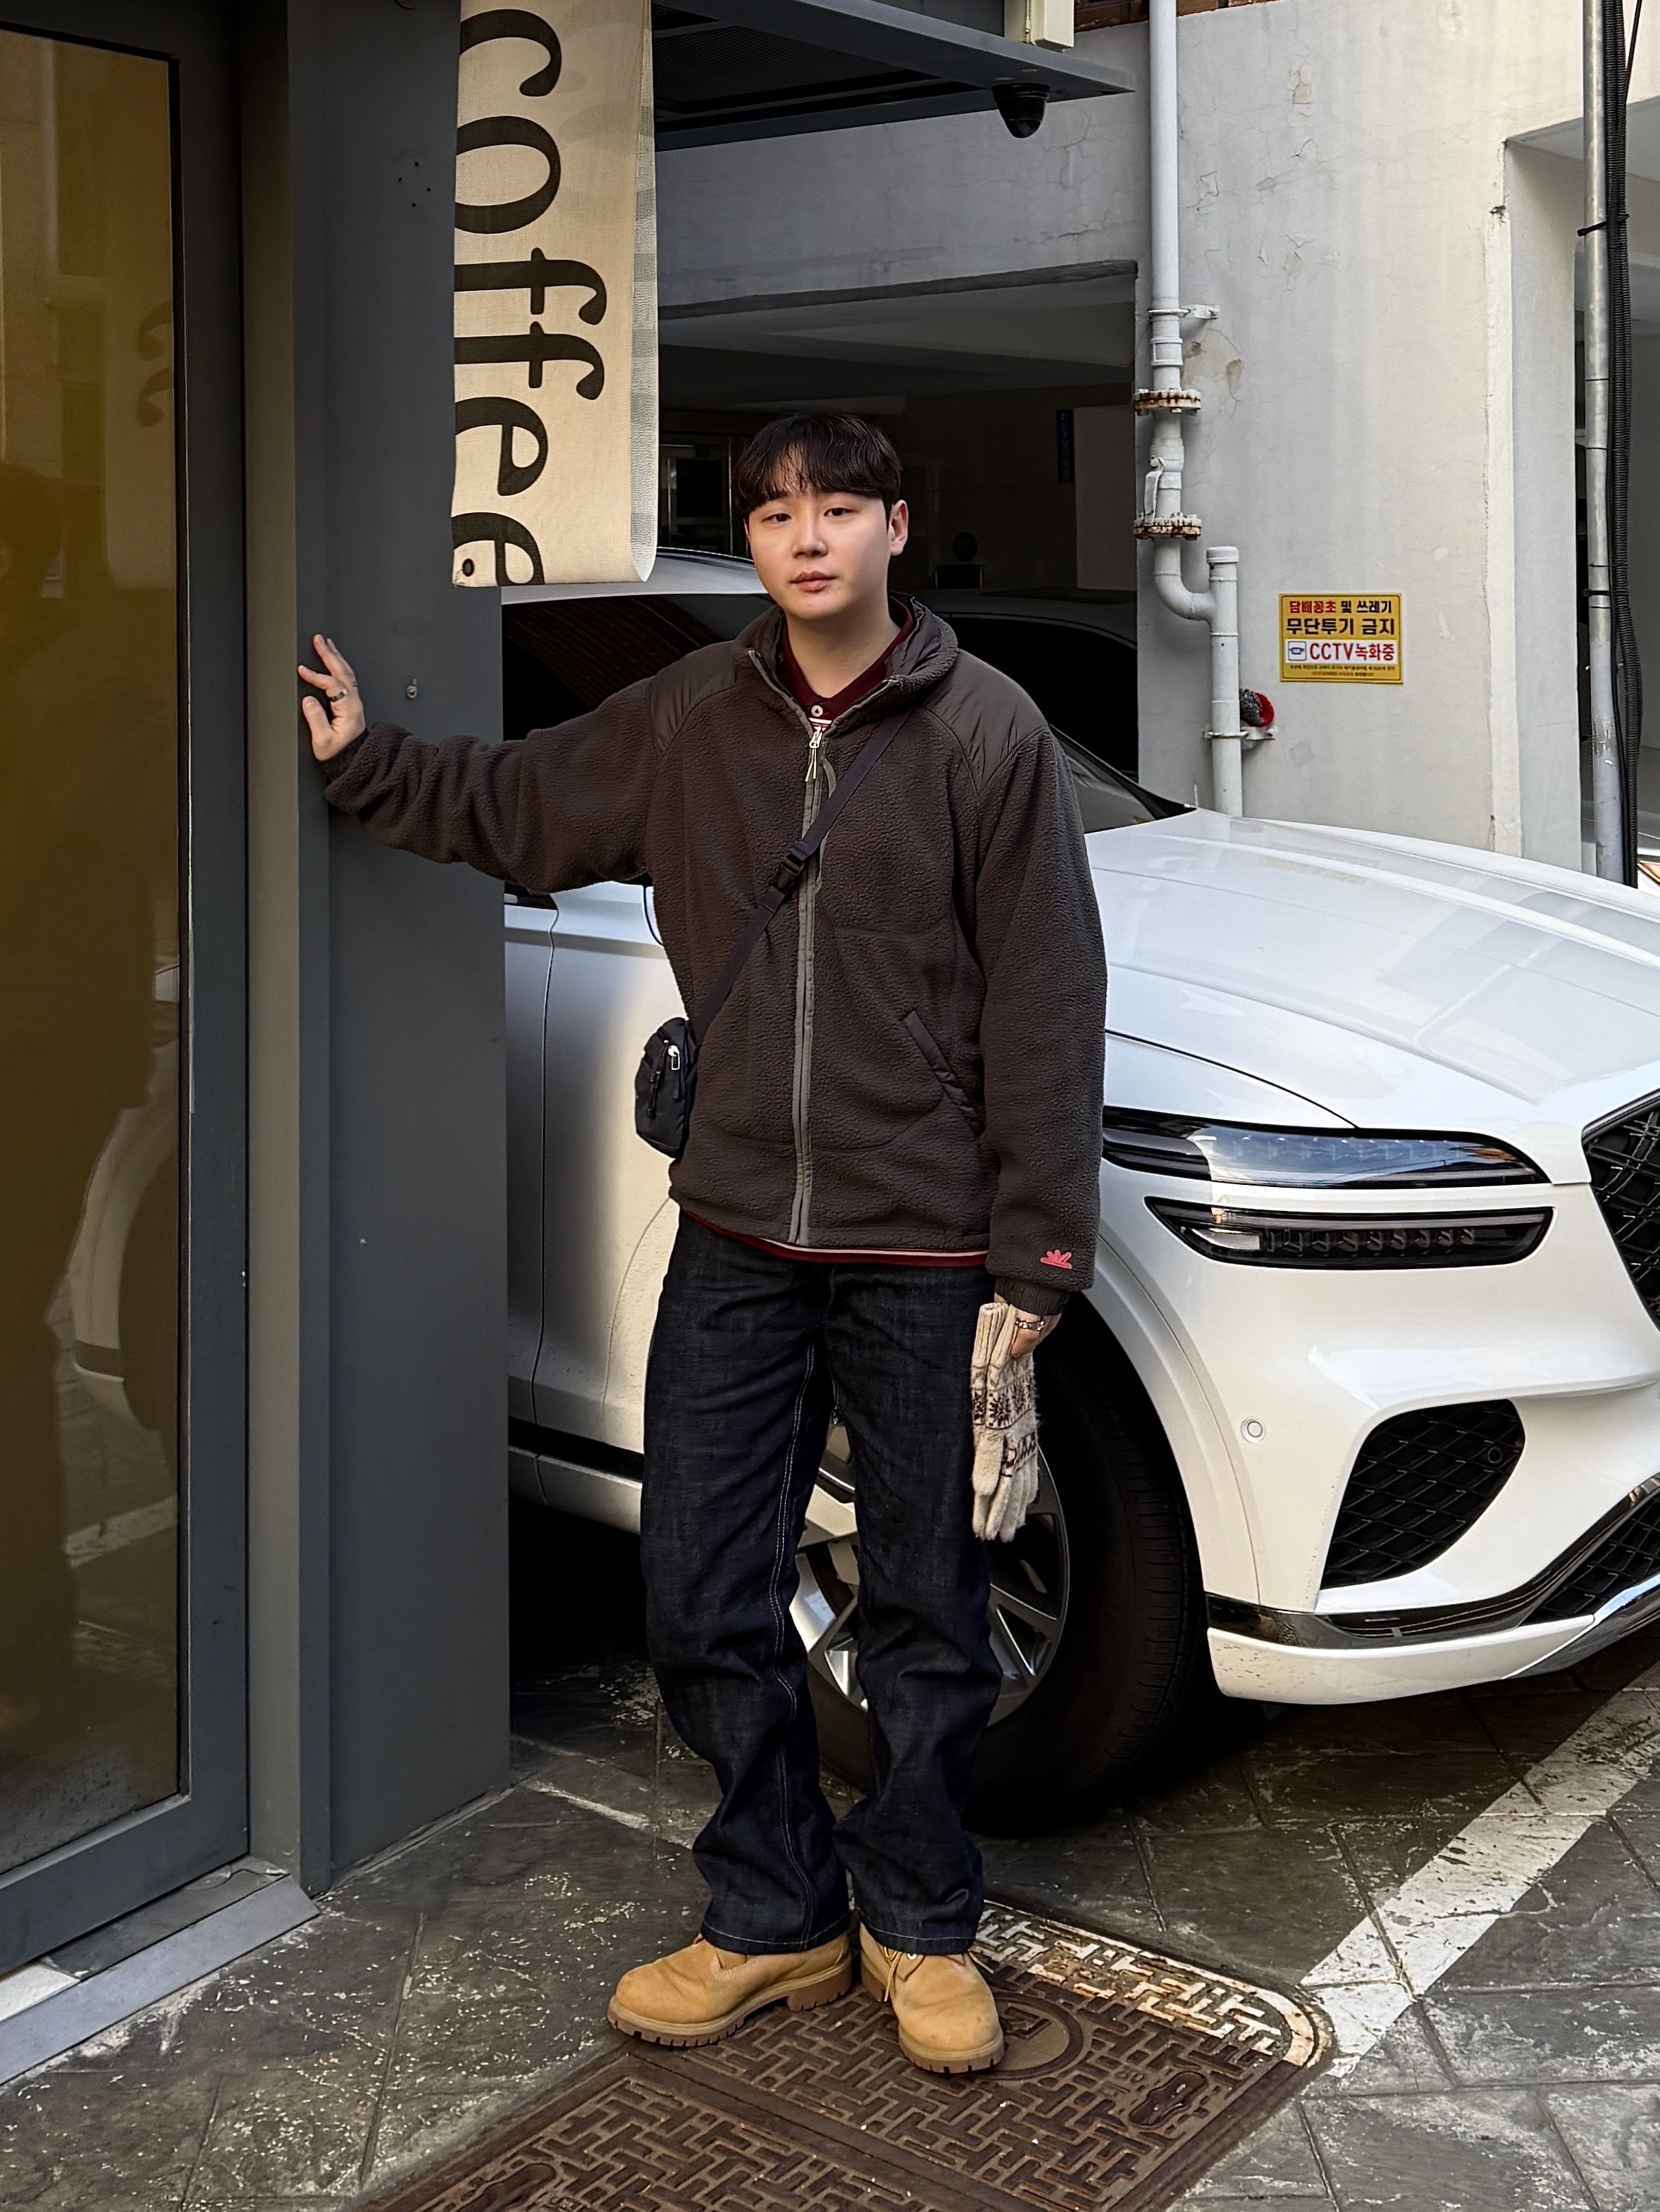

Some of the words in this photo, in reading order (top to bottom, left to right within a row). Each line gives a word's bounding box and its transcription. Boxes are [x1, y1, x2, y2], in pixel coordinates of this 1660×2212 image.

[452, 8, 607, 585] coffee
[1341, 600, 1352, 614] 및
[1356, 600, 1392, 614] 쓰레기
[1287, 618, 1354, 635] 무단투기
[1362, 618, 1394, 635] 금지
